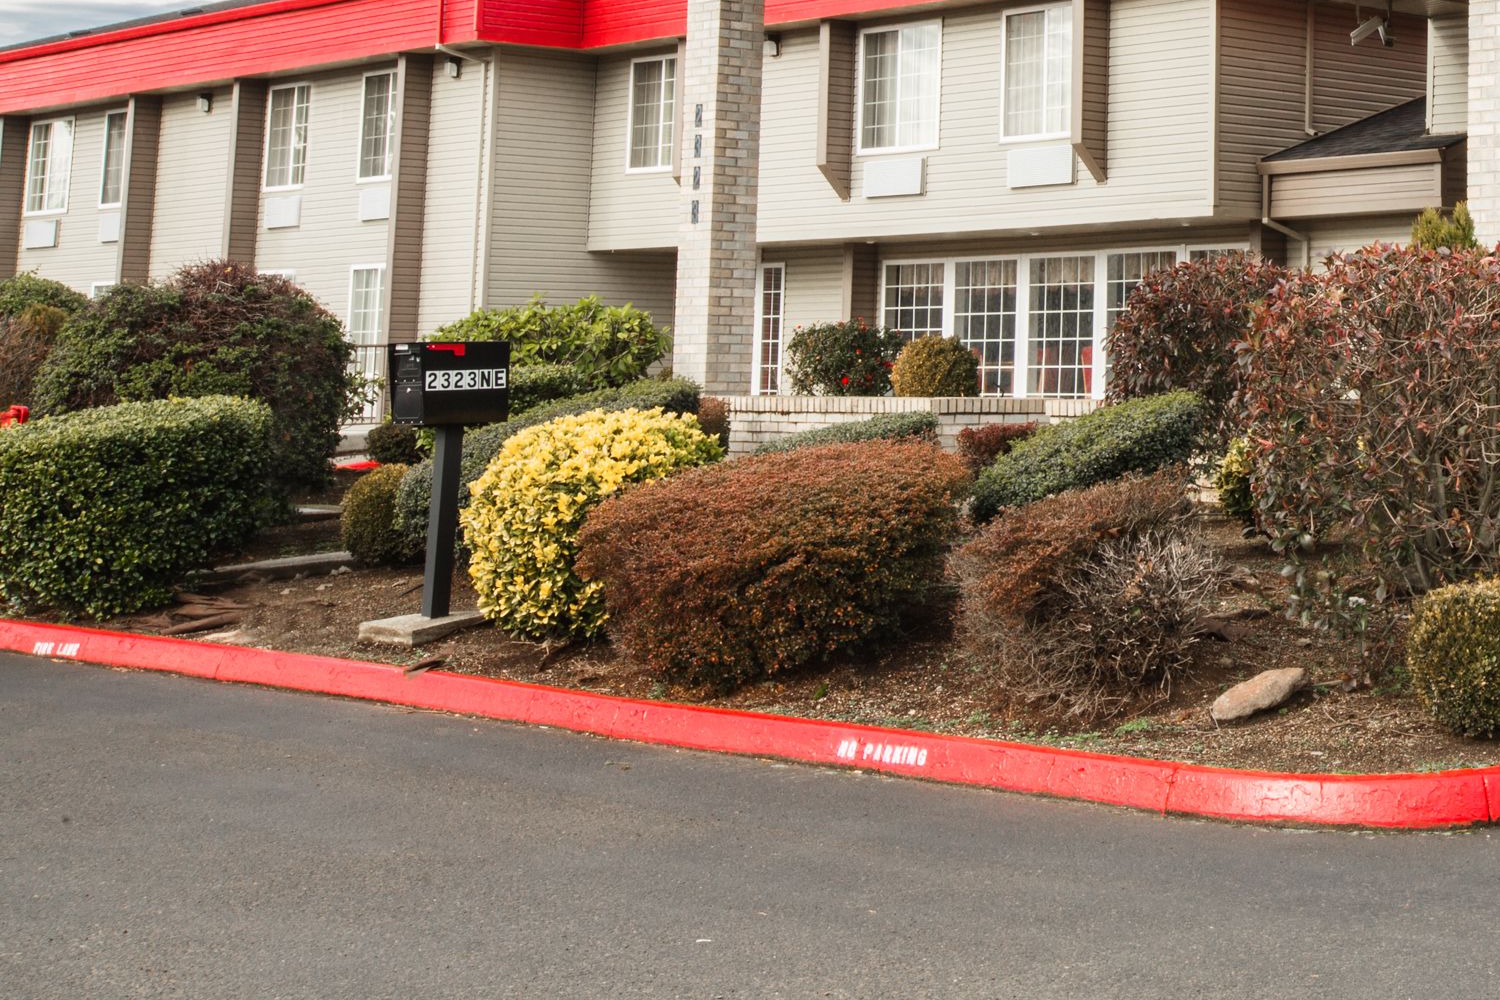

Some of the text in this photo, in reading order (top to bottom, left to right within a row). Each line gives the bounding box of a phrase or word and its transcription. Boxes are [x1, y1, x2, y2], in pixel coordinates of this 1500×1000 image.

[427, 370, 505, 389] 2323NE
[837, 739, 928, 766] NO PARKING
